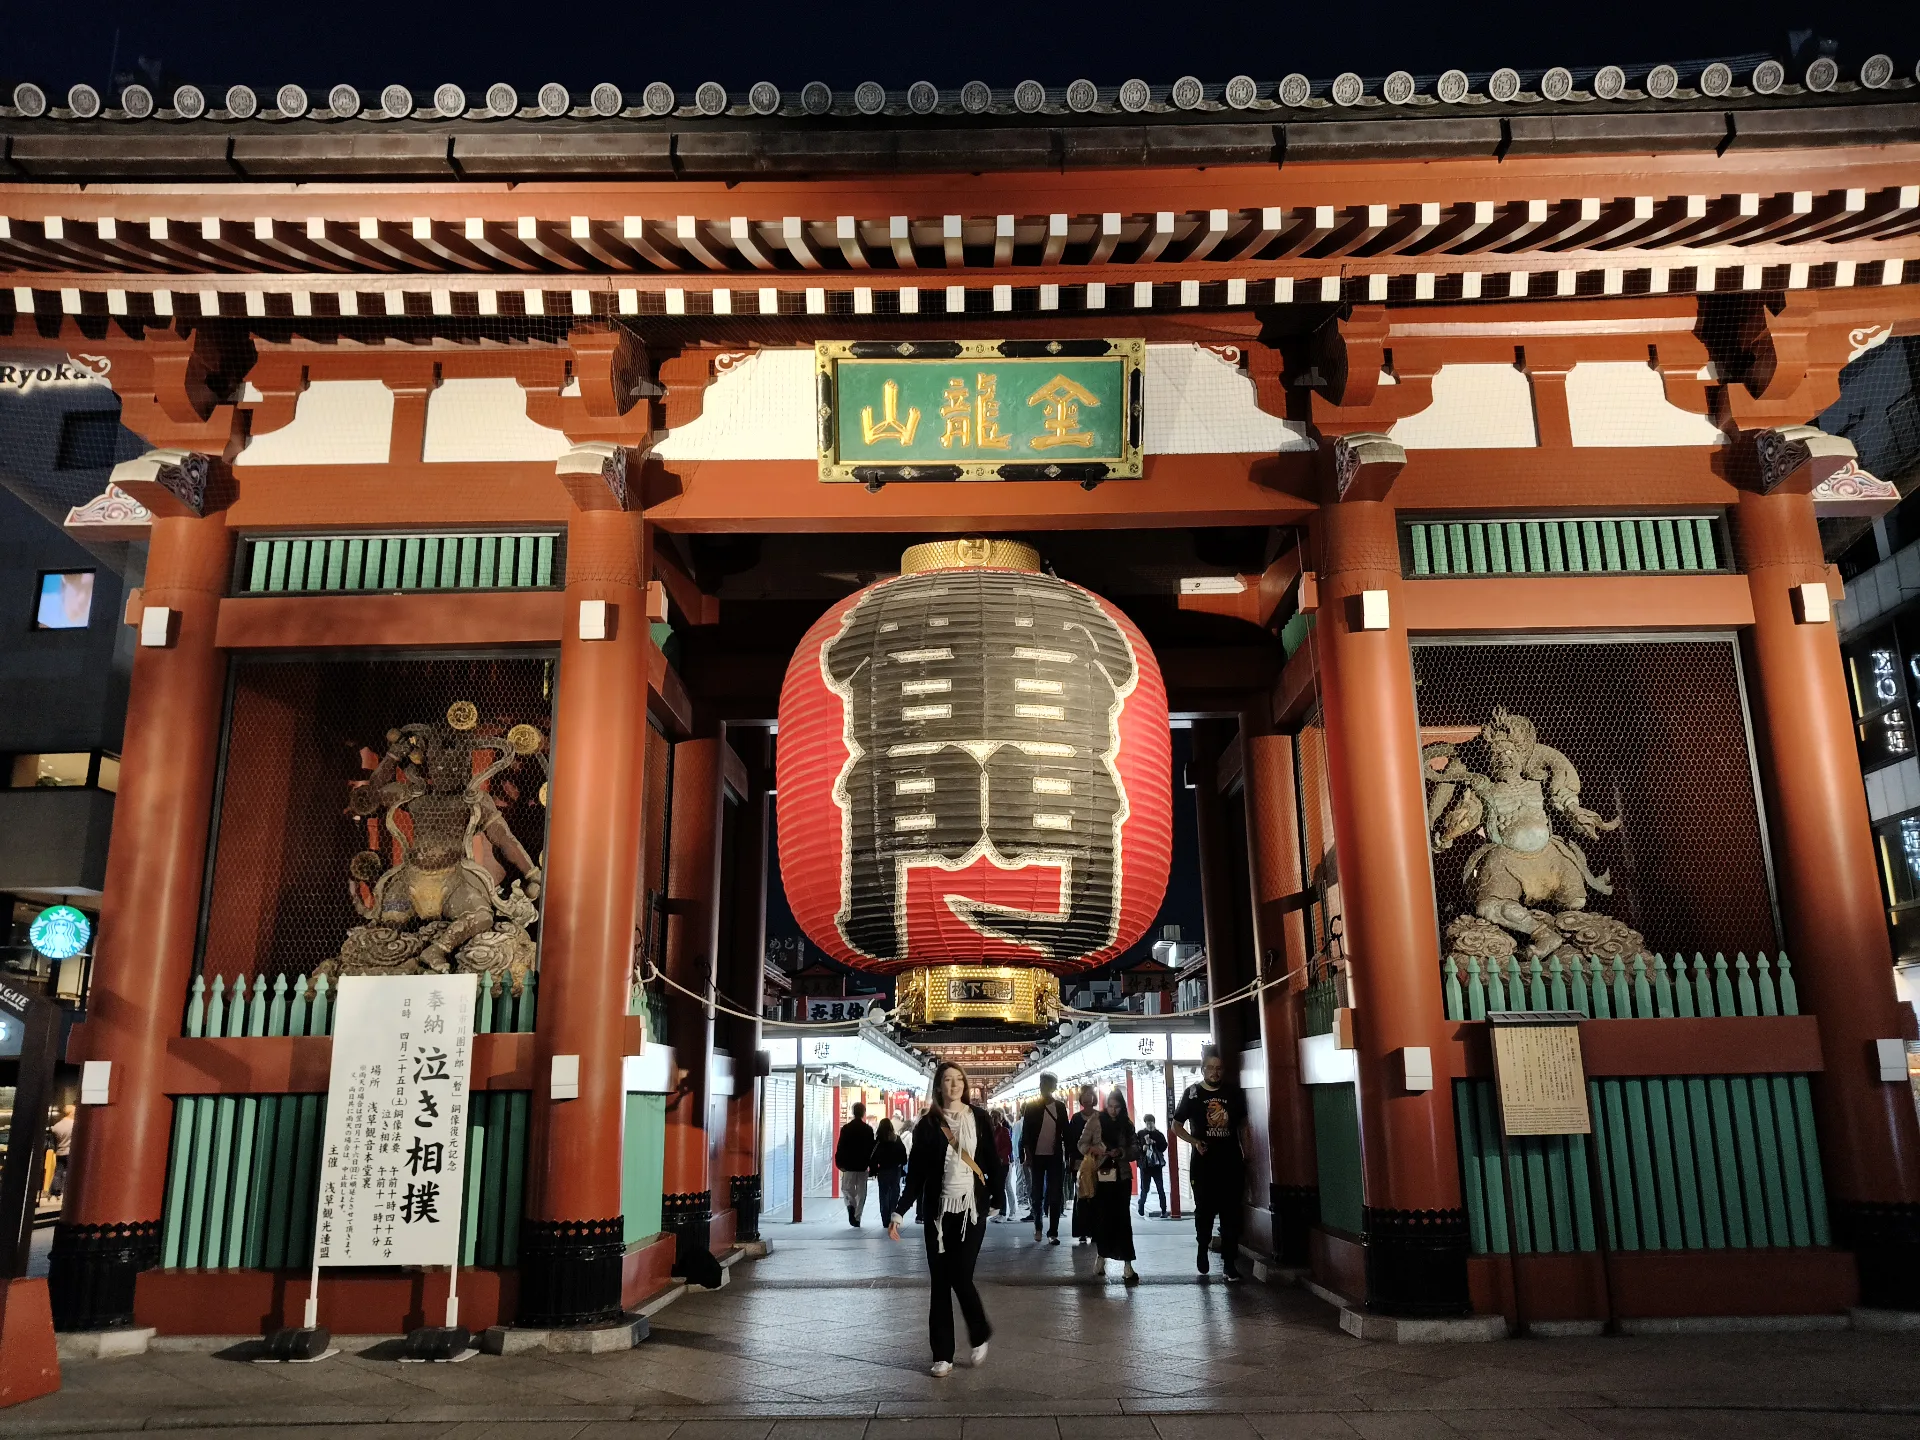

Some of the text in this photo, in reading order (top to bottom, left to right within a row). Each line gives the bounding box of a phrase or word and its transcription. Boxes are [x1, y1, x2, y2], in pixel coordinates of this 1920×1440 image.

[0, 363, 95, 389] Ryoka
[860, 372, 1101, 450] 金龍山
[820, 568, 1140, 960] 雷門
[951, 981, 1011, 999] 松下電器
[399, 1046, 450, 1225] 泣き相撲
